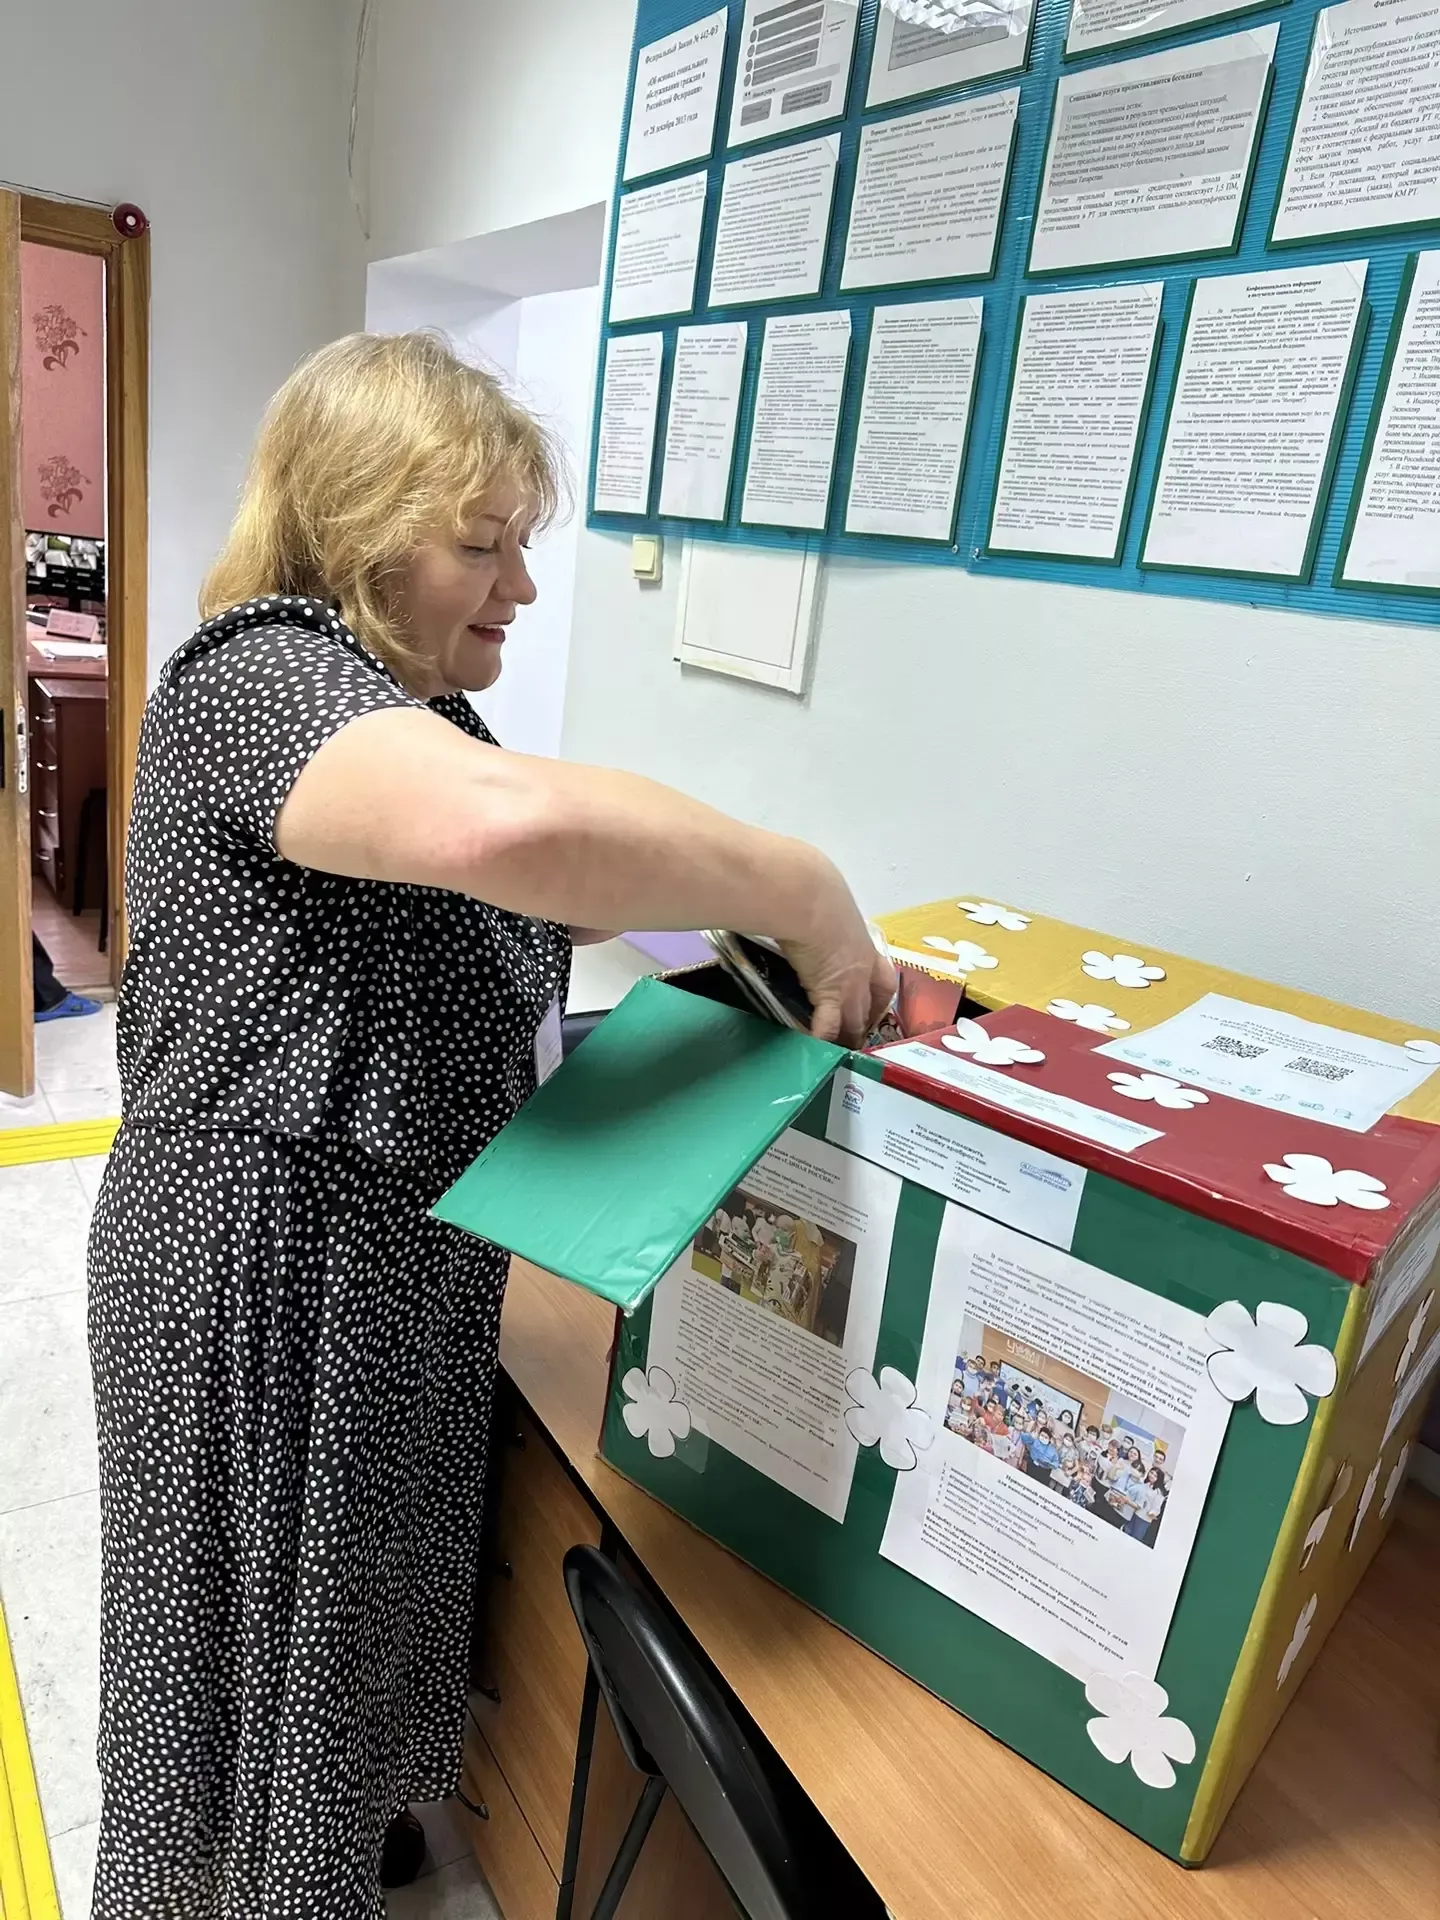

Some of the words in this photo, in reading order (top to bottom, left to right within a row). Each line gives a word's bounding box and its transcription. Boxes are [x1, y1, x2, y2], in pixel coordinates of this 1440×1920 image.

[645, 46, 677, 64] Федеральный
[677, 38, 692, 50] Закон
[700, 24, 718, 40] 442-ФЗ
[657, 70, 676, 83] основах
[676, 57, 708, 75] социального
[645, 81, 679, 99] обслуживания
[680, 73, 701, 88] граждан
[645, 95, 672, 112] Российской
[673, 86, 702, 101] Федерации»
[643, 129, 649, 137] от
[649, 125, 655, 135] 28
[655, 120, 674, 133] декабря
[674, 114, 686, 126] 2013
[686, 112, 698, 122] года
